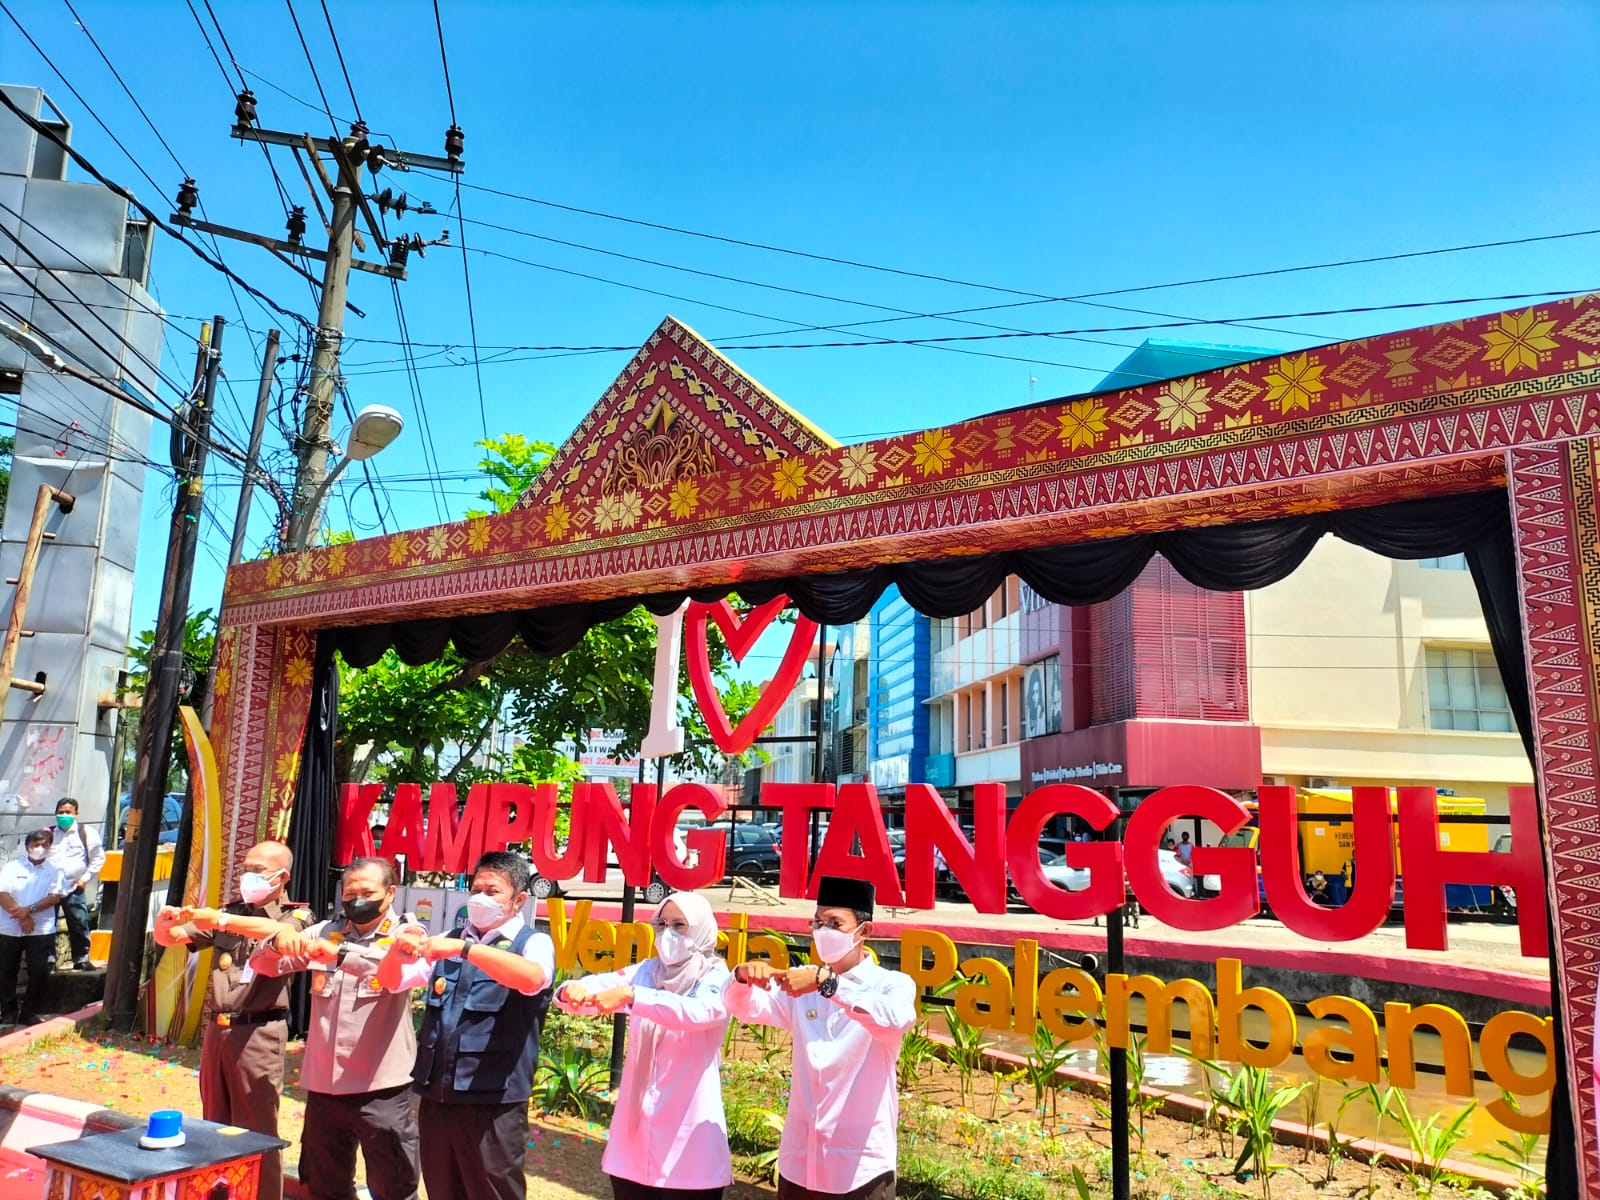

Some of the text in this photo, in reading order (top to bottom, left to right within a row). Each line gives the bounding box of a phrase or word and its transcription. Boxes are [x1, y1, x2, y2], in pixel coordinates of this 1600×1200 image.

[336, 782, 1549, 957] KAMPUNG TANGGUH
[901, 929, 1556, 1136] Palembang
